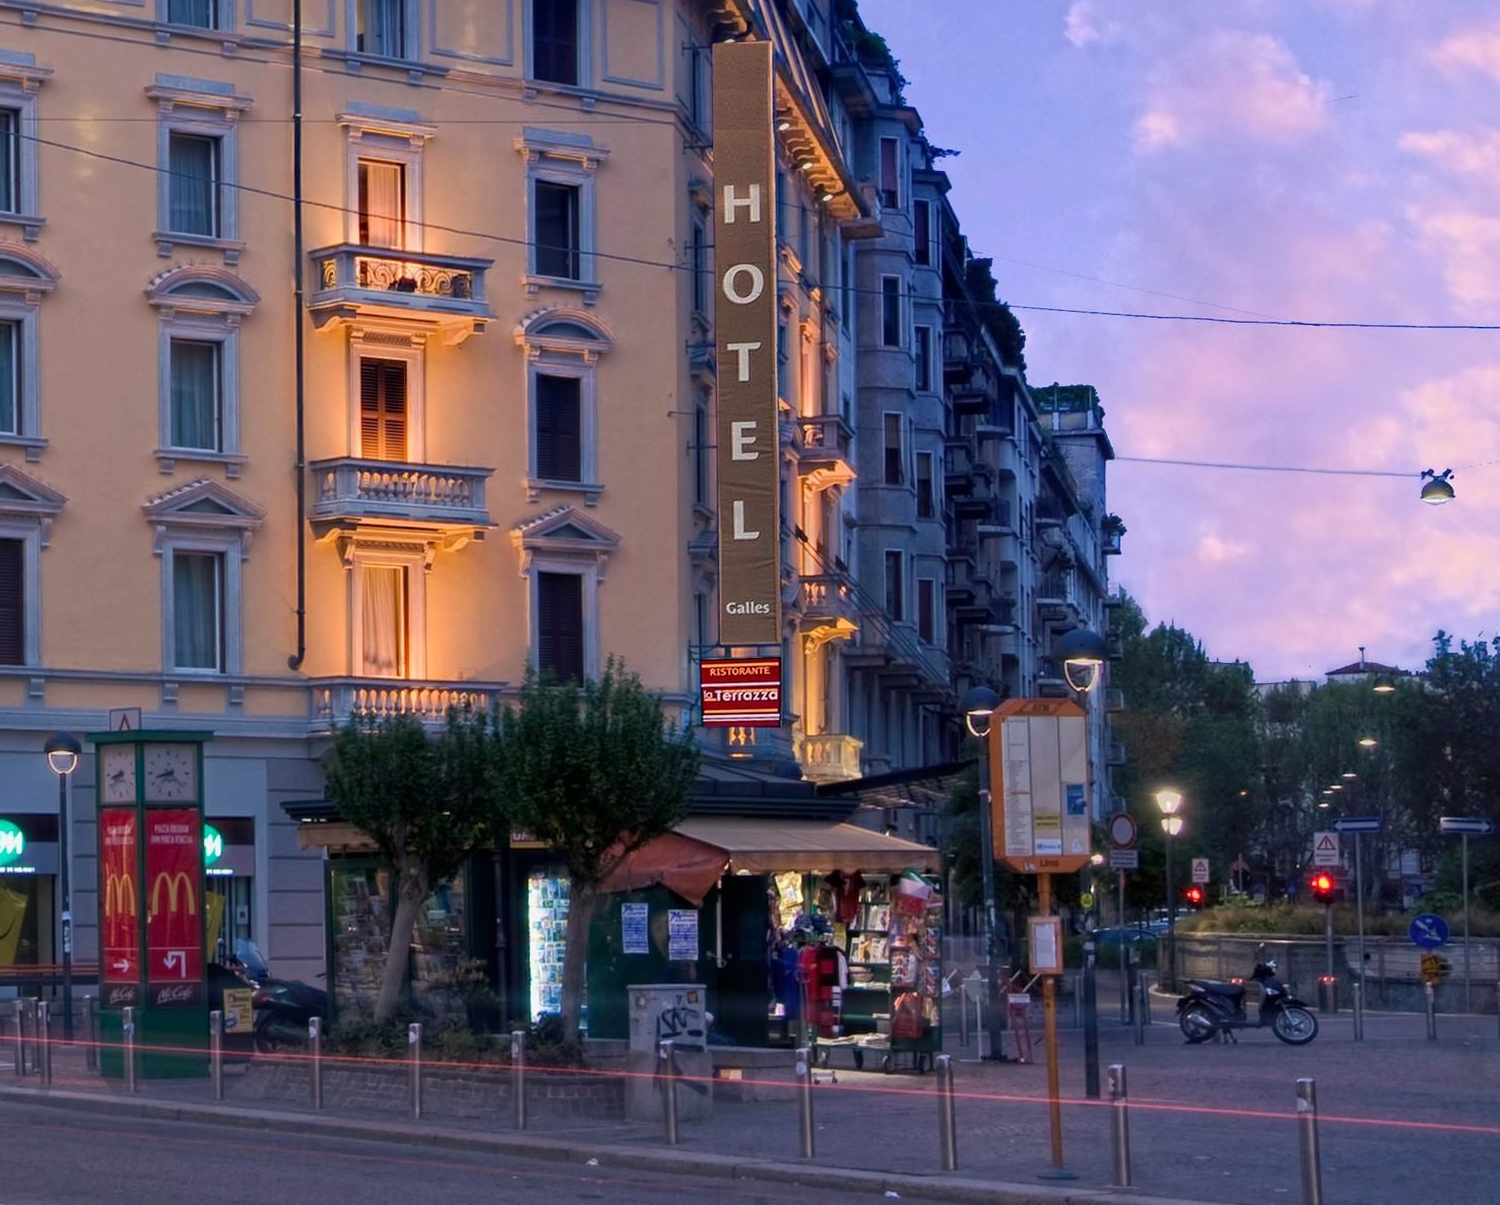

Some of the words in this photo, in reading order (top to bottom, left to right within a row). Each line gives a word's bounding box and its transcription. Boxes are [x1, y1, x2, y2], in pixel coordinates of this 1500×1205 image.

[721, 183, 765, 541] HOTEL
[725, 601, 770, 615] Galles
[709, 666, 771, 677] RISTORANTE
[703, 690, 713, 700] la
[715, 688, 779, 702] Terrazza
